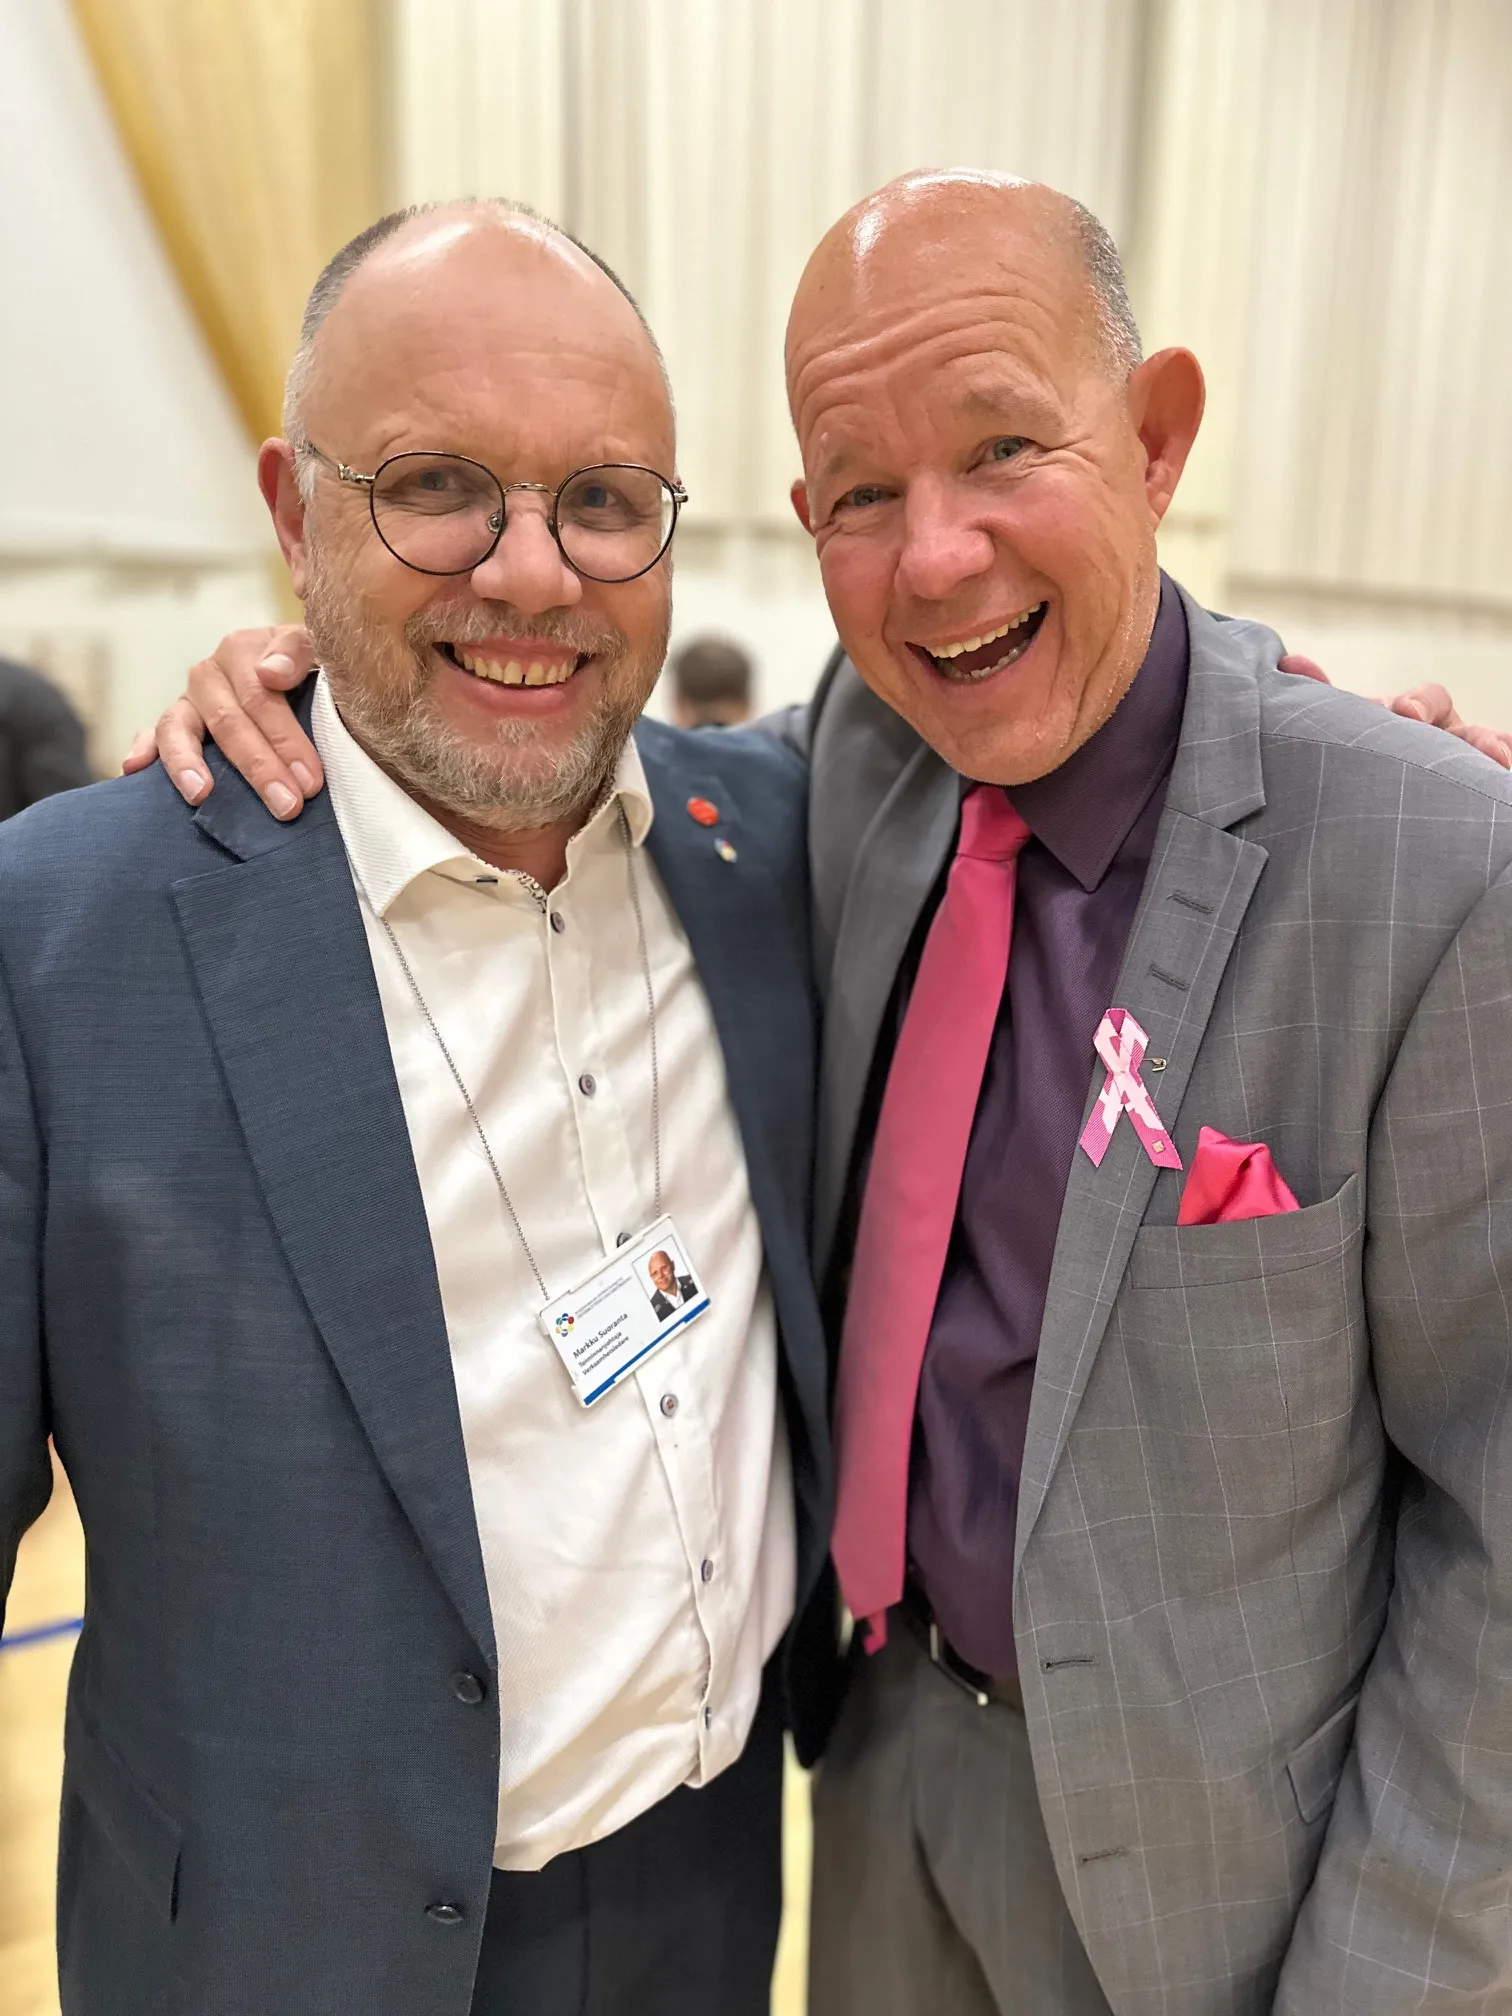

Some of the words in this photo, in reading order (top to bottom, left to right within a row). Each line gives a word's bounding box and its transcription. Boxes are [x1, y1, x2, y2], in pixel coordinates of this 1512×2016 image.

[573, 1336, 599, 1359] Markku
[598, 1313, 628, 1338] Suoranta
[578, 1332, 622, 1367] Toiminnanjohtaja
[582, 1336, 629, 1375] Verksamhetsledare
